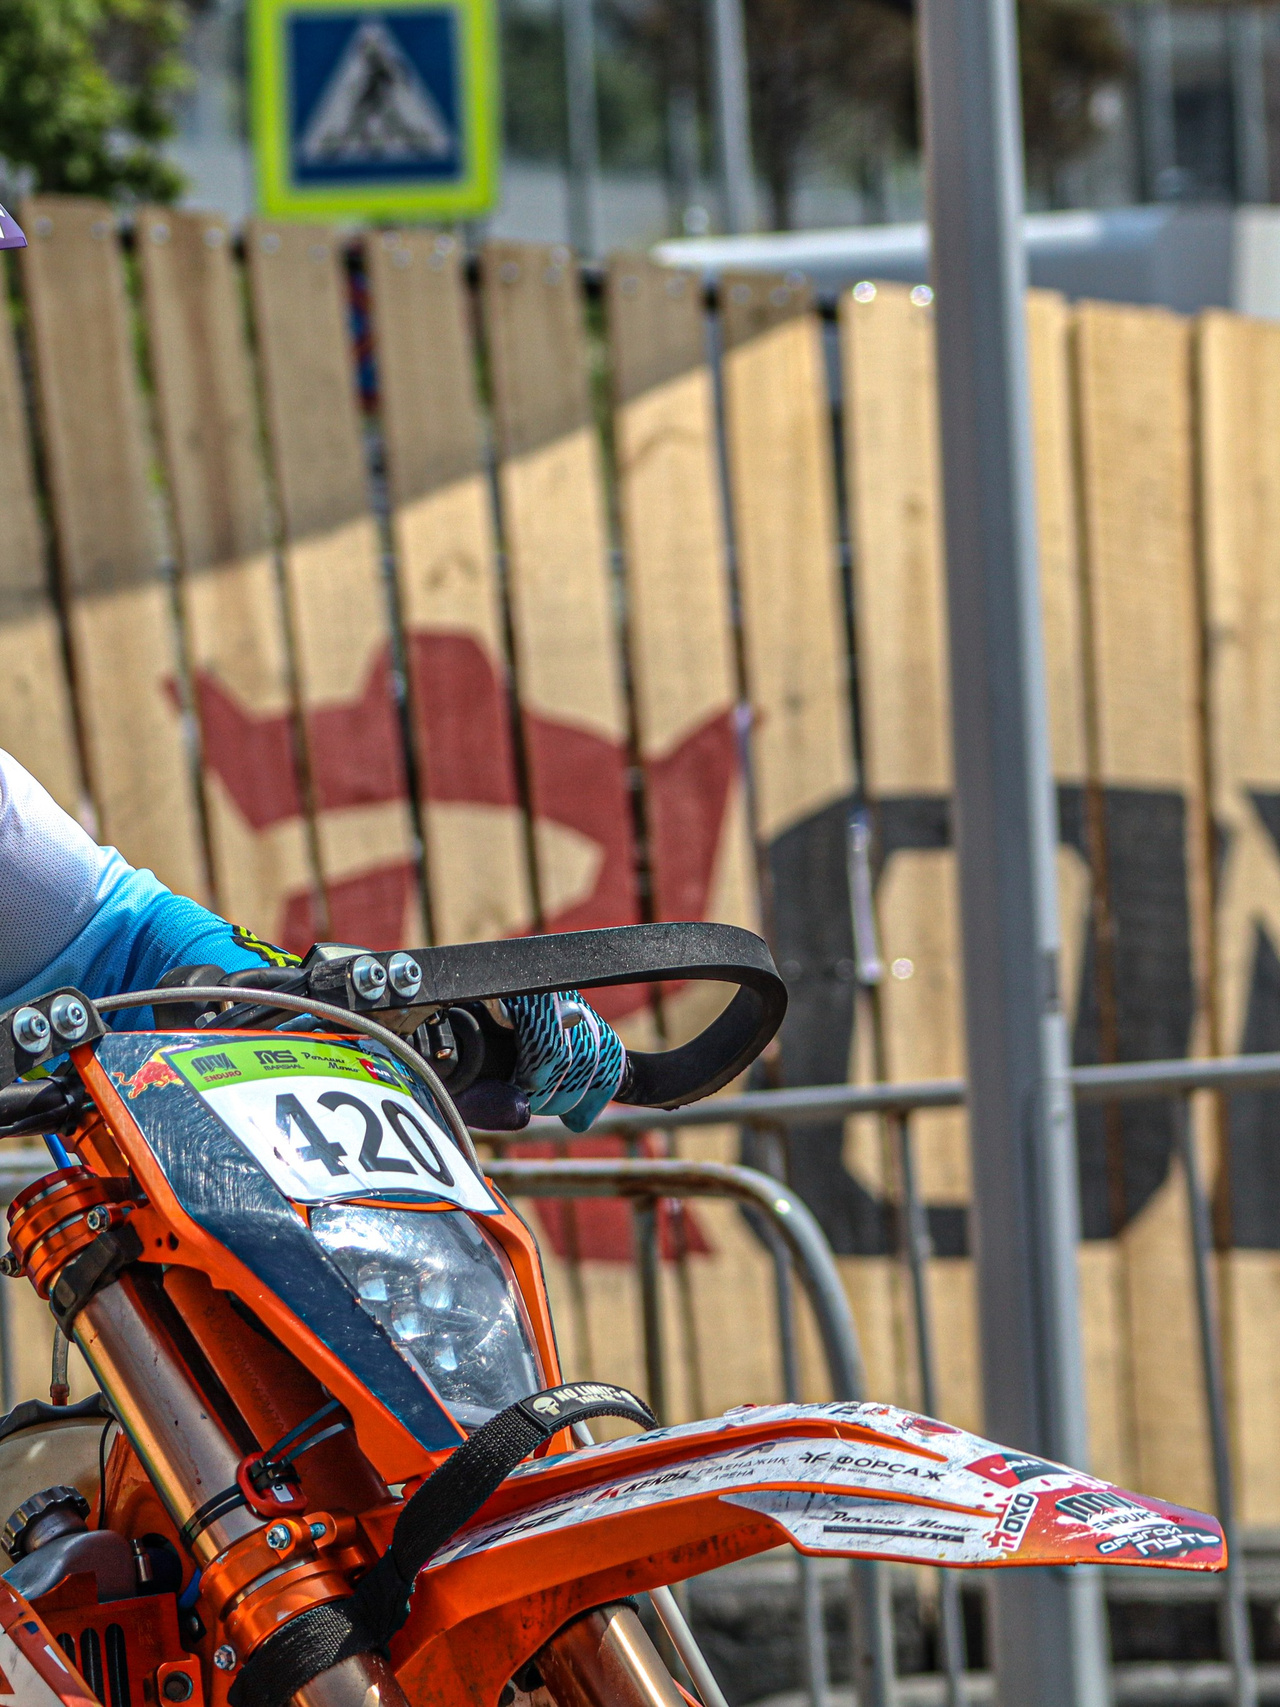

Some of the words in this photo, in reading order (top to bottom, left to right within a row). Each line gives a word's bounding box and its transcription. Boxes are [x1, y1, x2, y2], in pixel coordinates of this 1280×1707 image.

[203, 1070, 242, 1083] ENDURO
[263, 1063, 305, 1071] MARSHAL
[275, 1090, 456, 1187] 420
[553, 1388, 579, 1402] NO
[836, 1455, 947, 1482] ФОРСАЖ
[623, 1469, 691, 1494] KENDA
[1099, 1525, 1183, 1554] ДРУГОЙ
[1135, 1532, 1221, 1556] ПУТЬ
